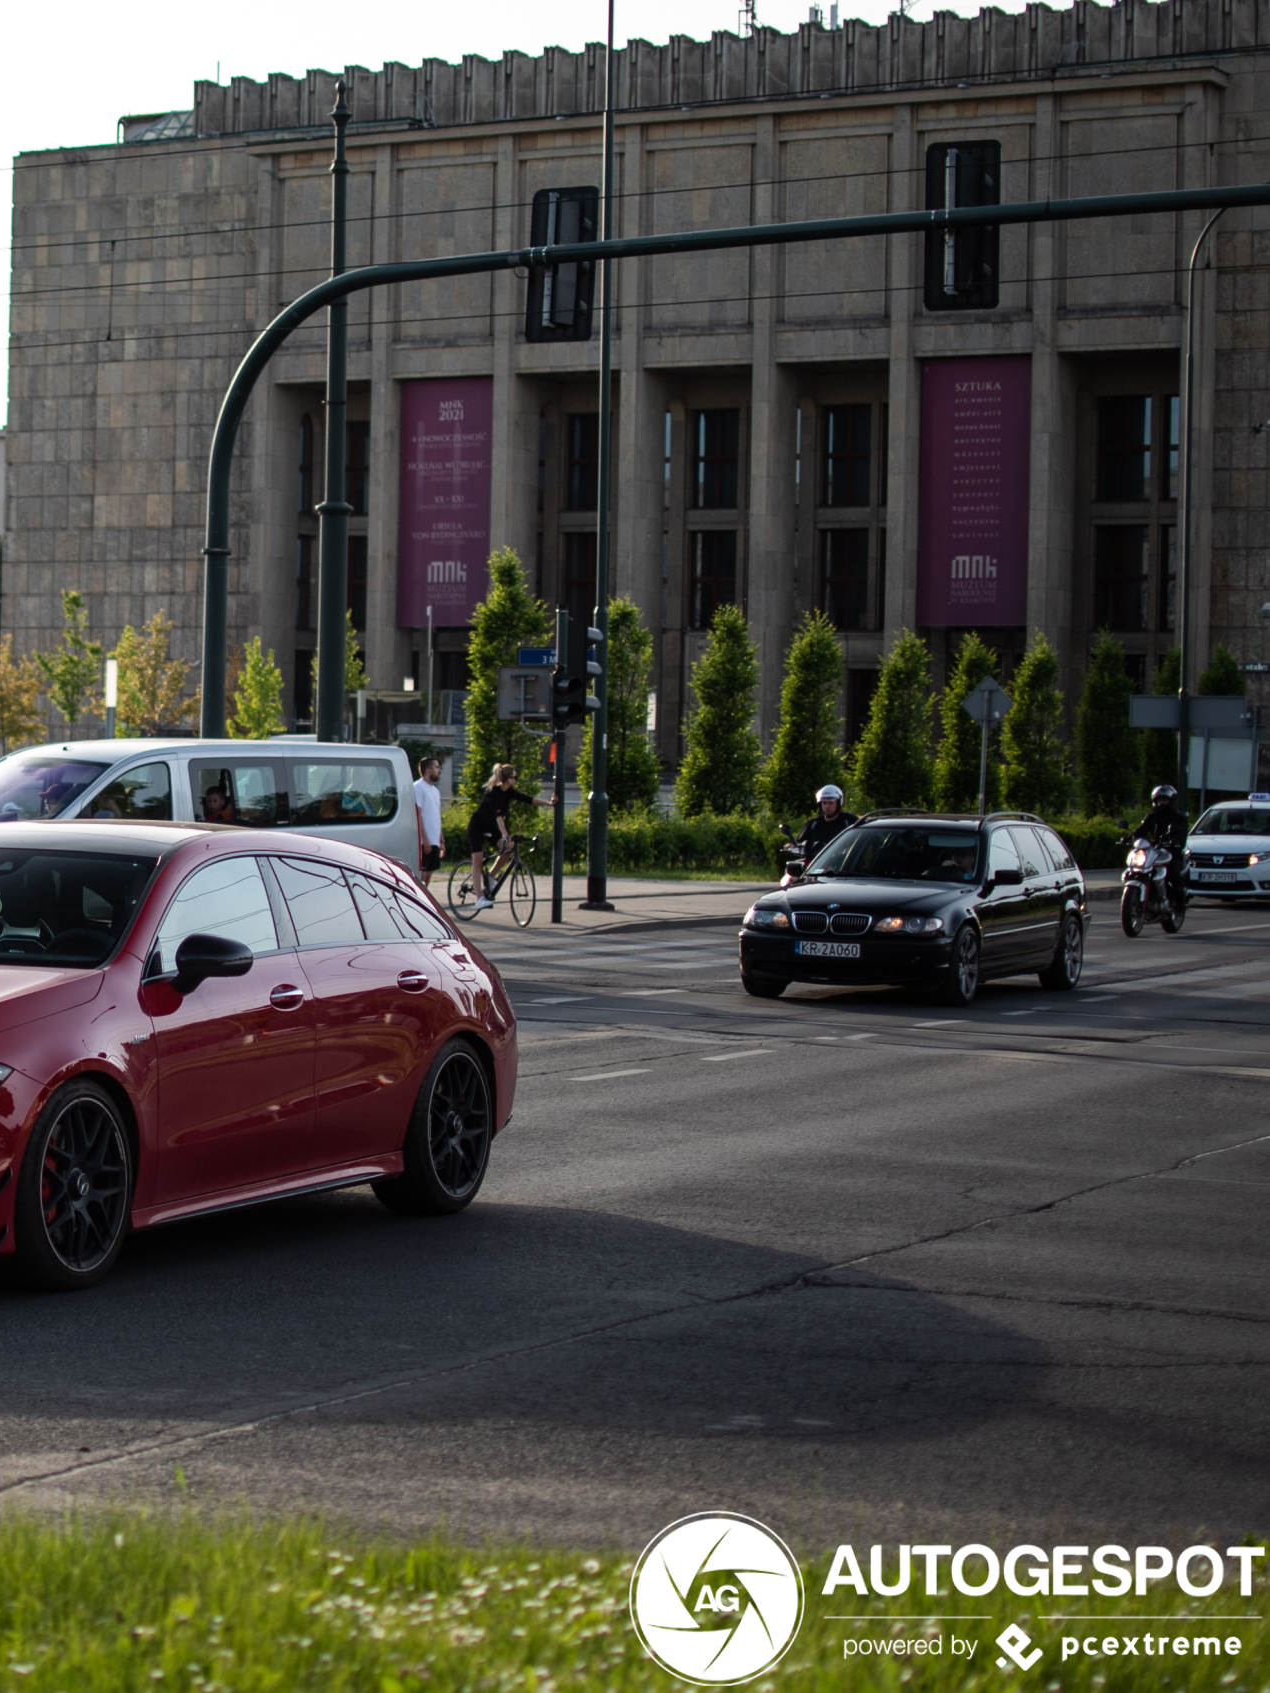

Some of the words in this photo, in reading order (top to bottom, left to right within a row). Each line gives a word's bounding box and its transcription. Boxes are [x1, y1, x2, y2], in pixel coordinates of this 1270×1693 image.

[954, 381, 1002, 392] SZTUKA
[438, 400, 464, 409] MNK
[438, 409, 464, 421] 2021
[433, 522, 463, 531] URSULA
[427, 584, 468, 593] MUZEUM
[951, 580, 998, 589] MUZEUM
[801, 942, 818, 955] KR
[821, 943, 859, 957] 2A060
